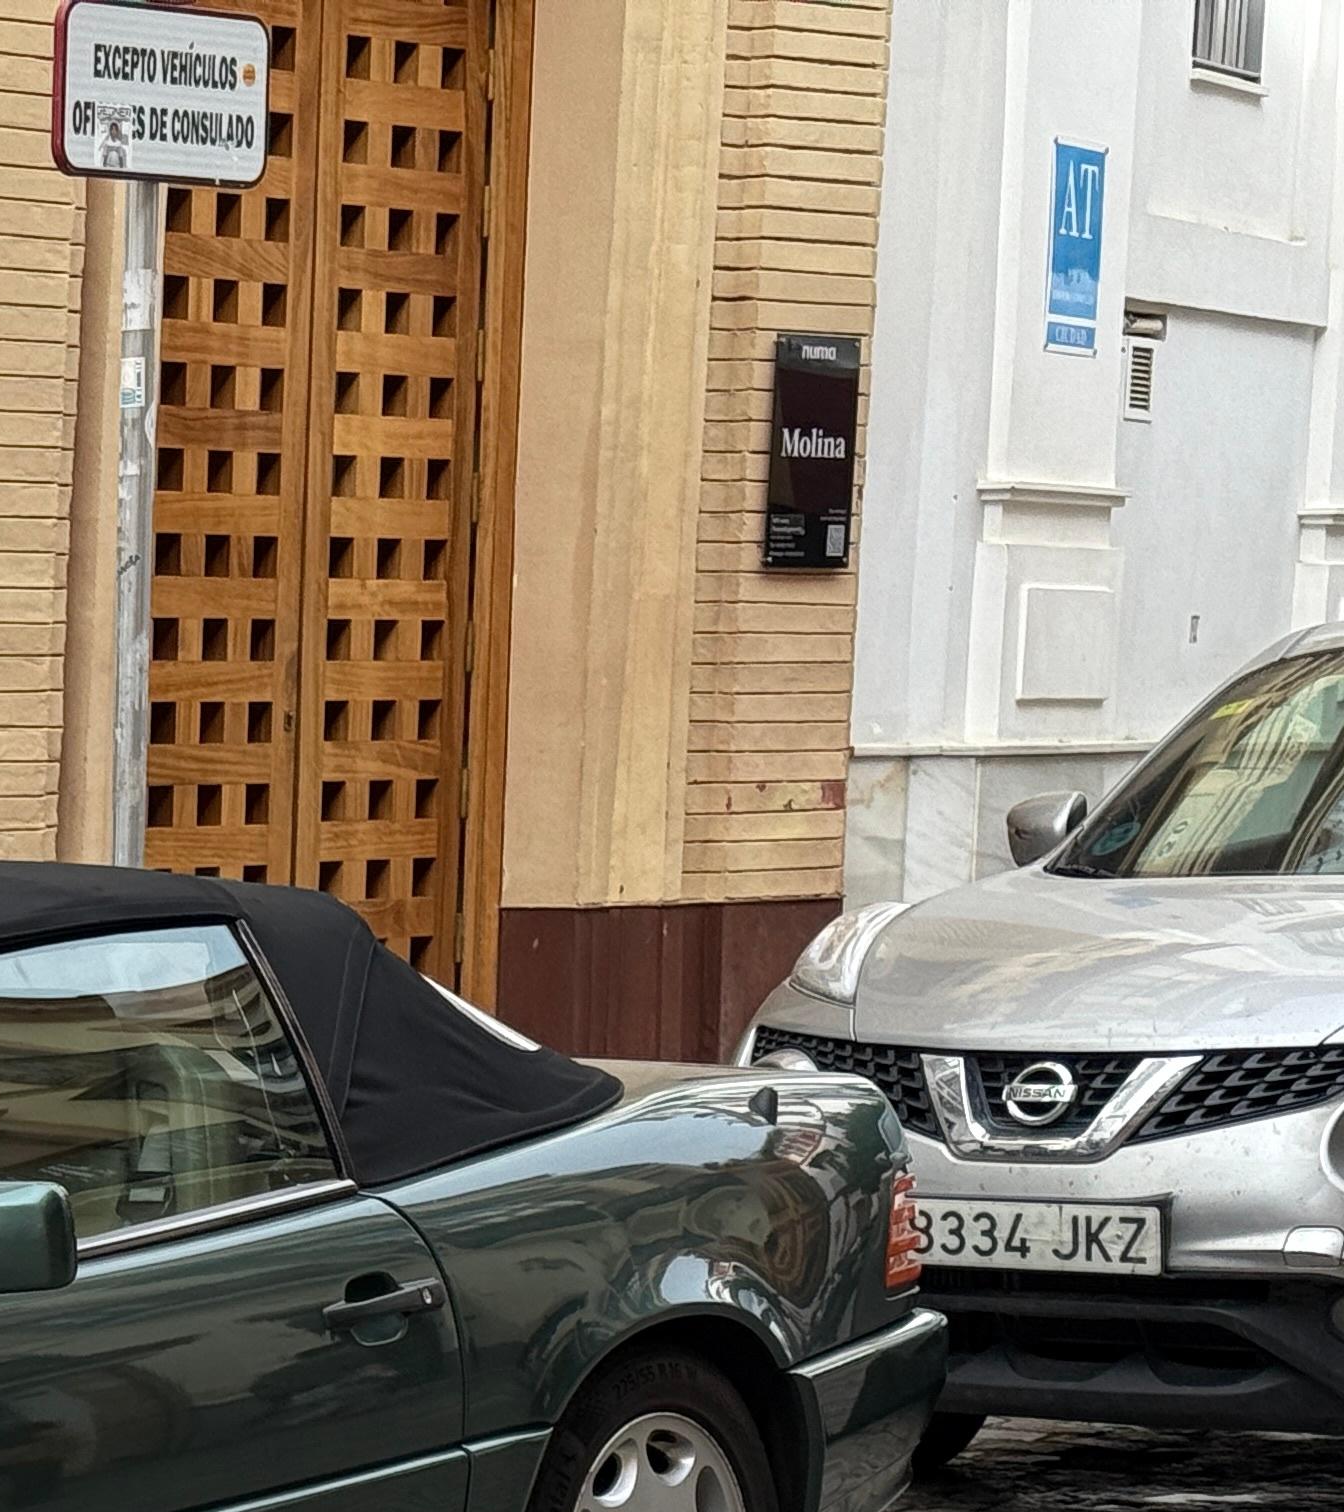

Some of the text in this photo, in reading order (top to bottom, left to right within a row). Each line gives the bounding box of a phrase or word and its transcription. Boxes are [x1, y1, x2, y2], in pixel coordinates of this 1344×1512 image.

[93, 41, 238, 91] EXCEPTO VEHÍCULOS
[149, 107, 168, 143] DE
[172, 109, 254, 149] CONSULADO
[1059, 159, 1099, 240] AT
[780, 427, 846, 459] Molina
[1010, 1086, 1066, 1098] NISSAN
[1052, 1214, 1148, 1265] JKZ
